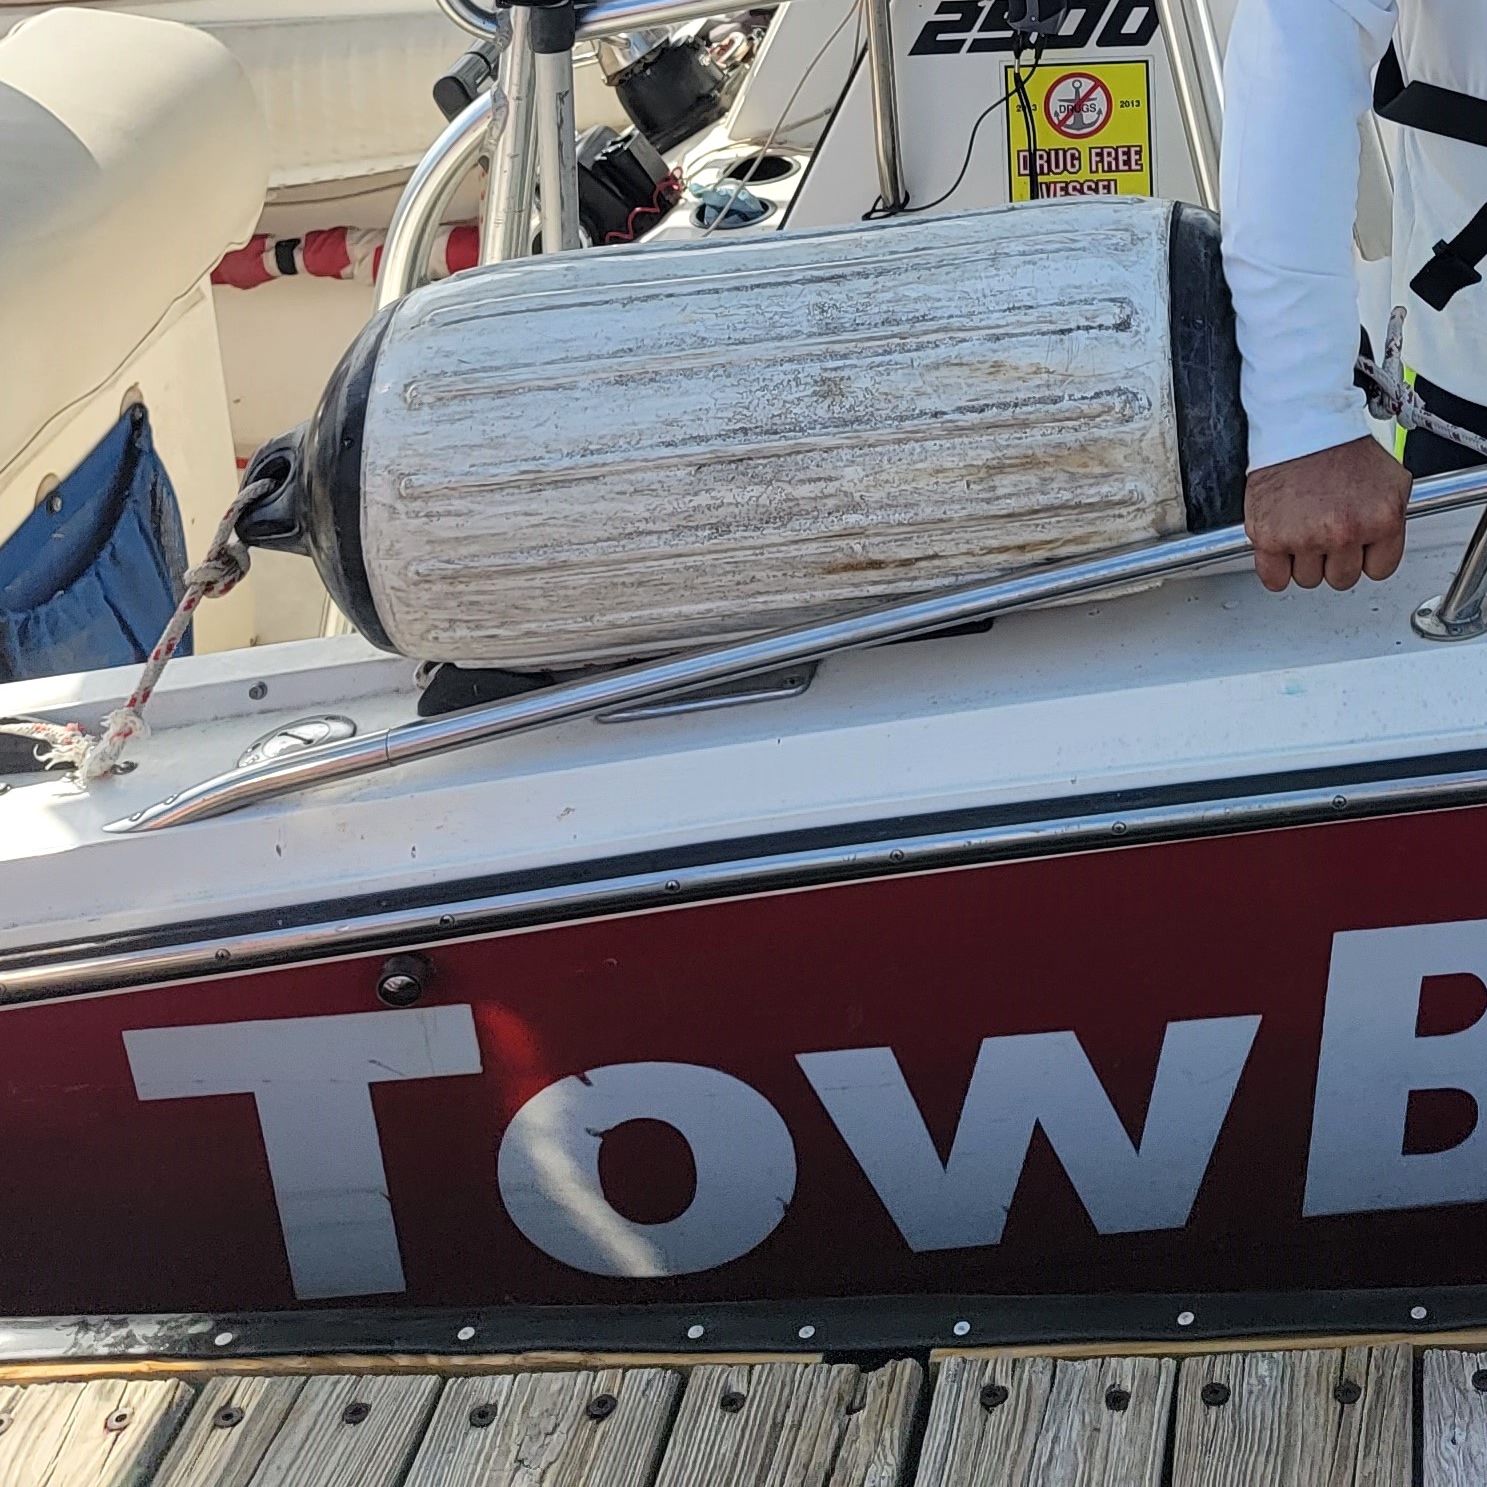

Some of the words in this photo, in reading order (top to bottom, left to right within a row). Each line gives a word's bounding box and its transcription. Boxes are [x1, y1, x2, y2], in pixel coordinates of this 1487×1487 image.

[1058, 102, 1097, 114] DRUGS
[1119, 99, 1141, 109] 2013
[1017, 147, 1082, 176] DRUG
[1088, 145, 1144, 174] FREE
